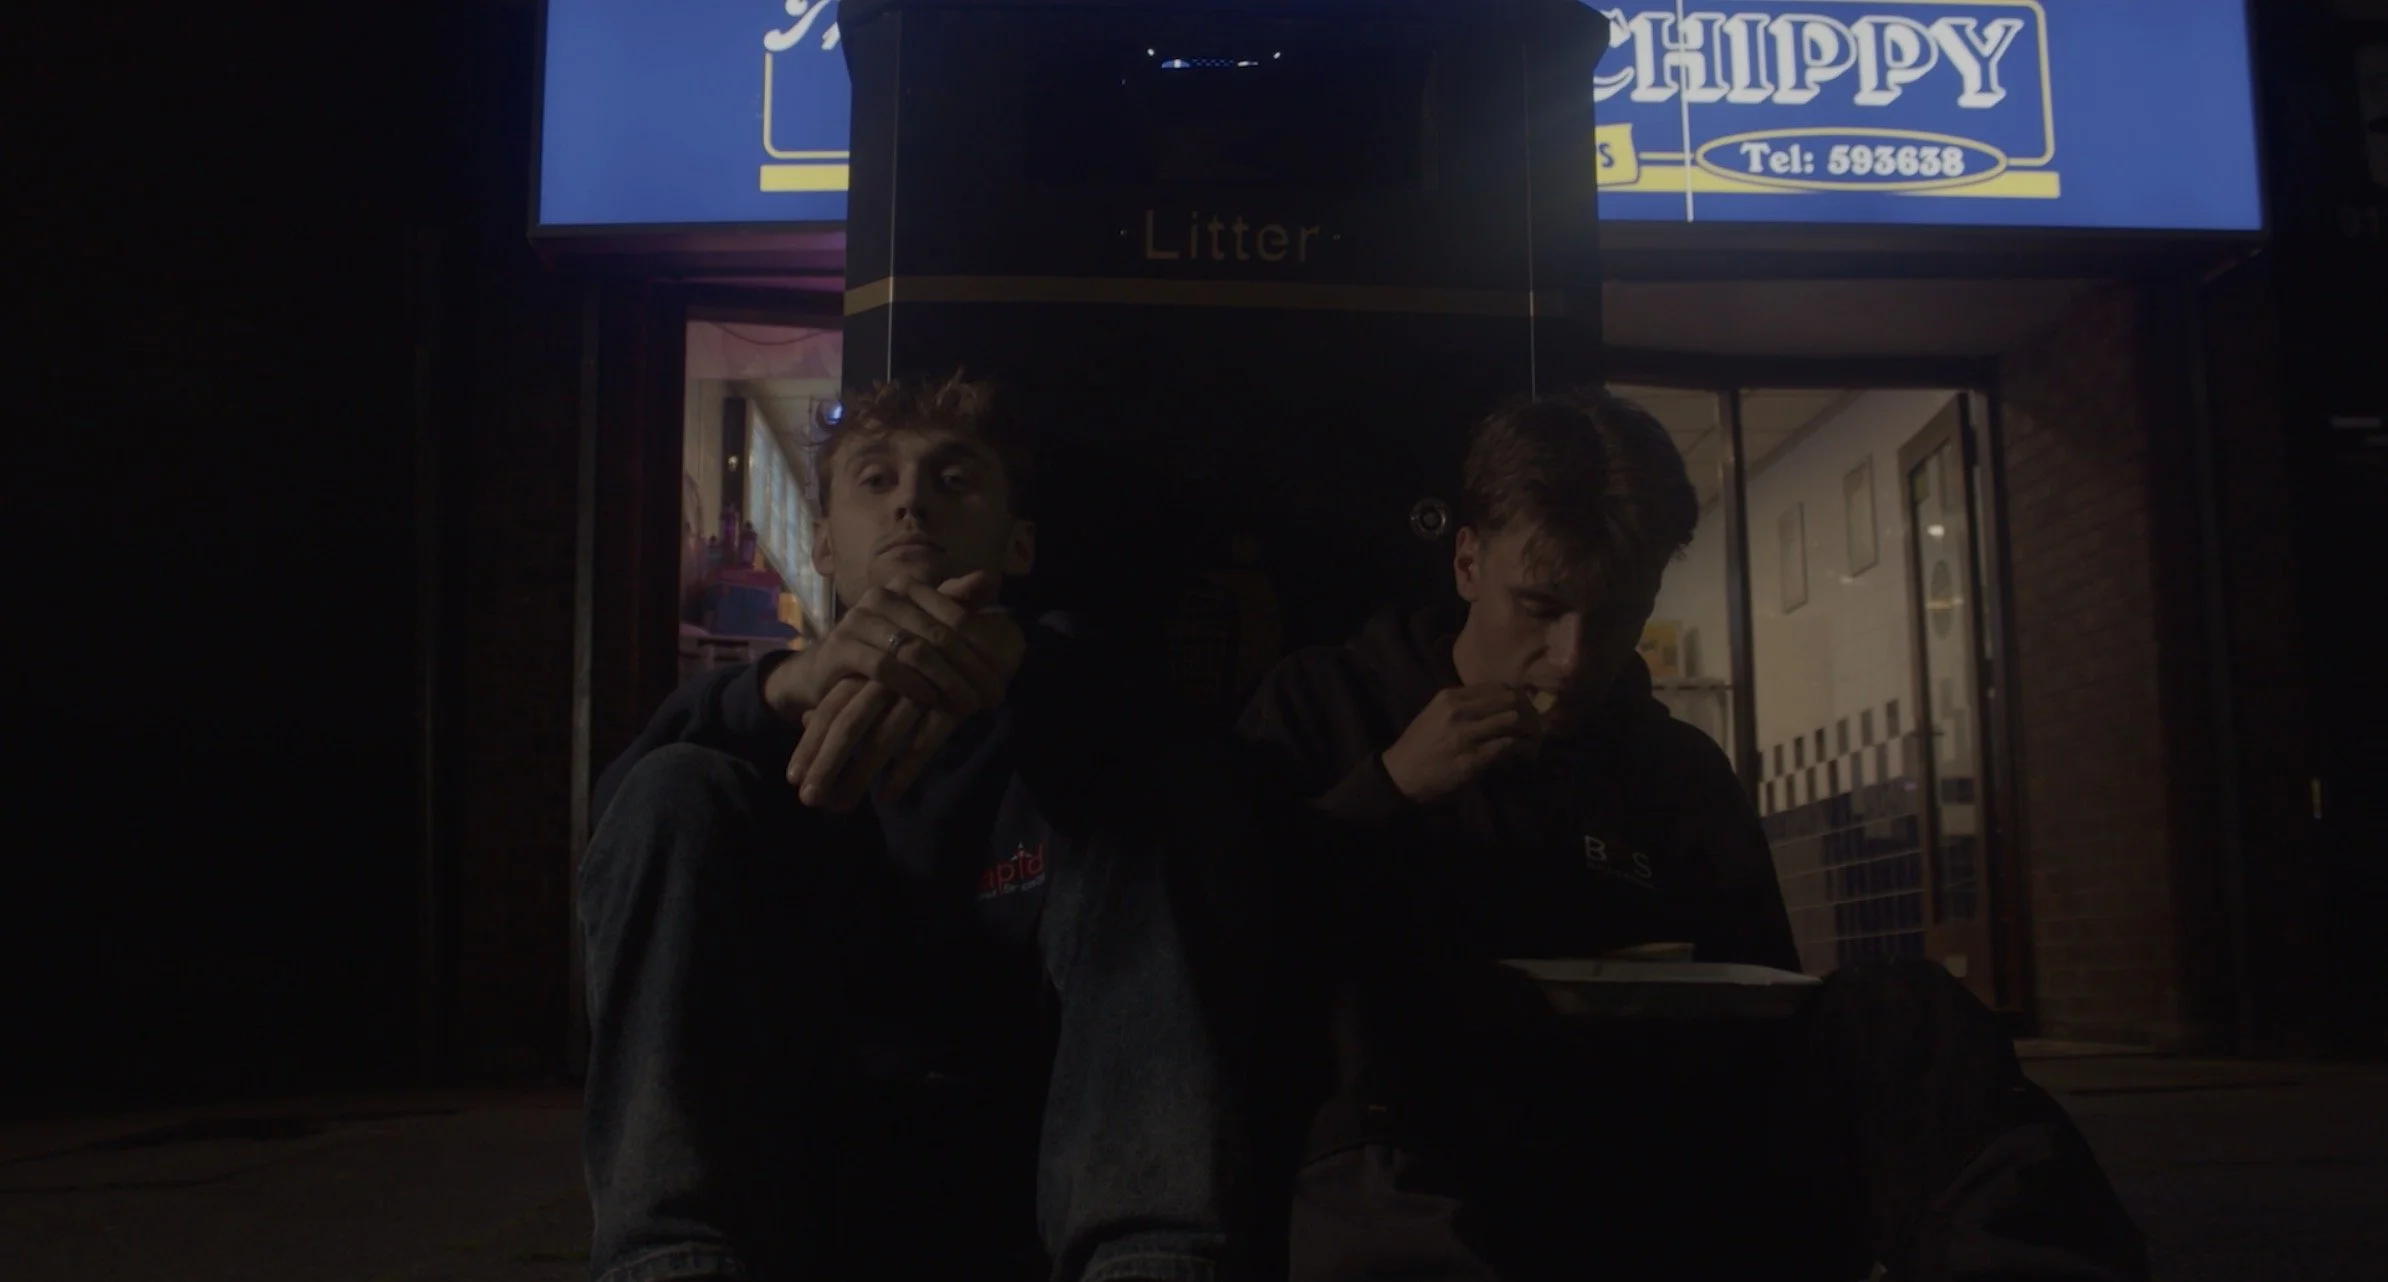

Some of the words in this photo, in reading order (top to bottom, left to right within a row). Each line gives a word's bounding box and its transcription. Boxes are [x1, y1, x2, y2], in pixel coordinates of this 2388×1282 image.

[1741, 141, 1815, 175] Tel:
[1827, 145, 1966, 178] 593638
[1143, 208, 1322, 263] Litter
